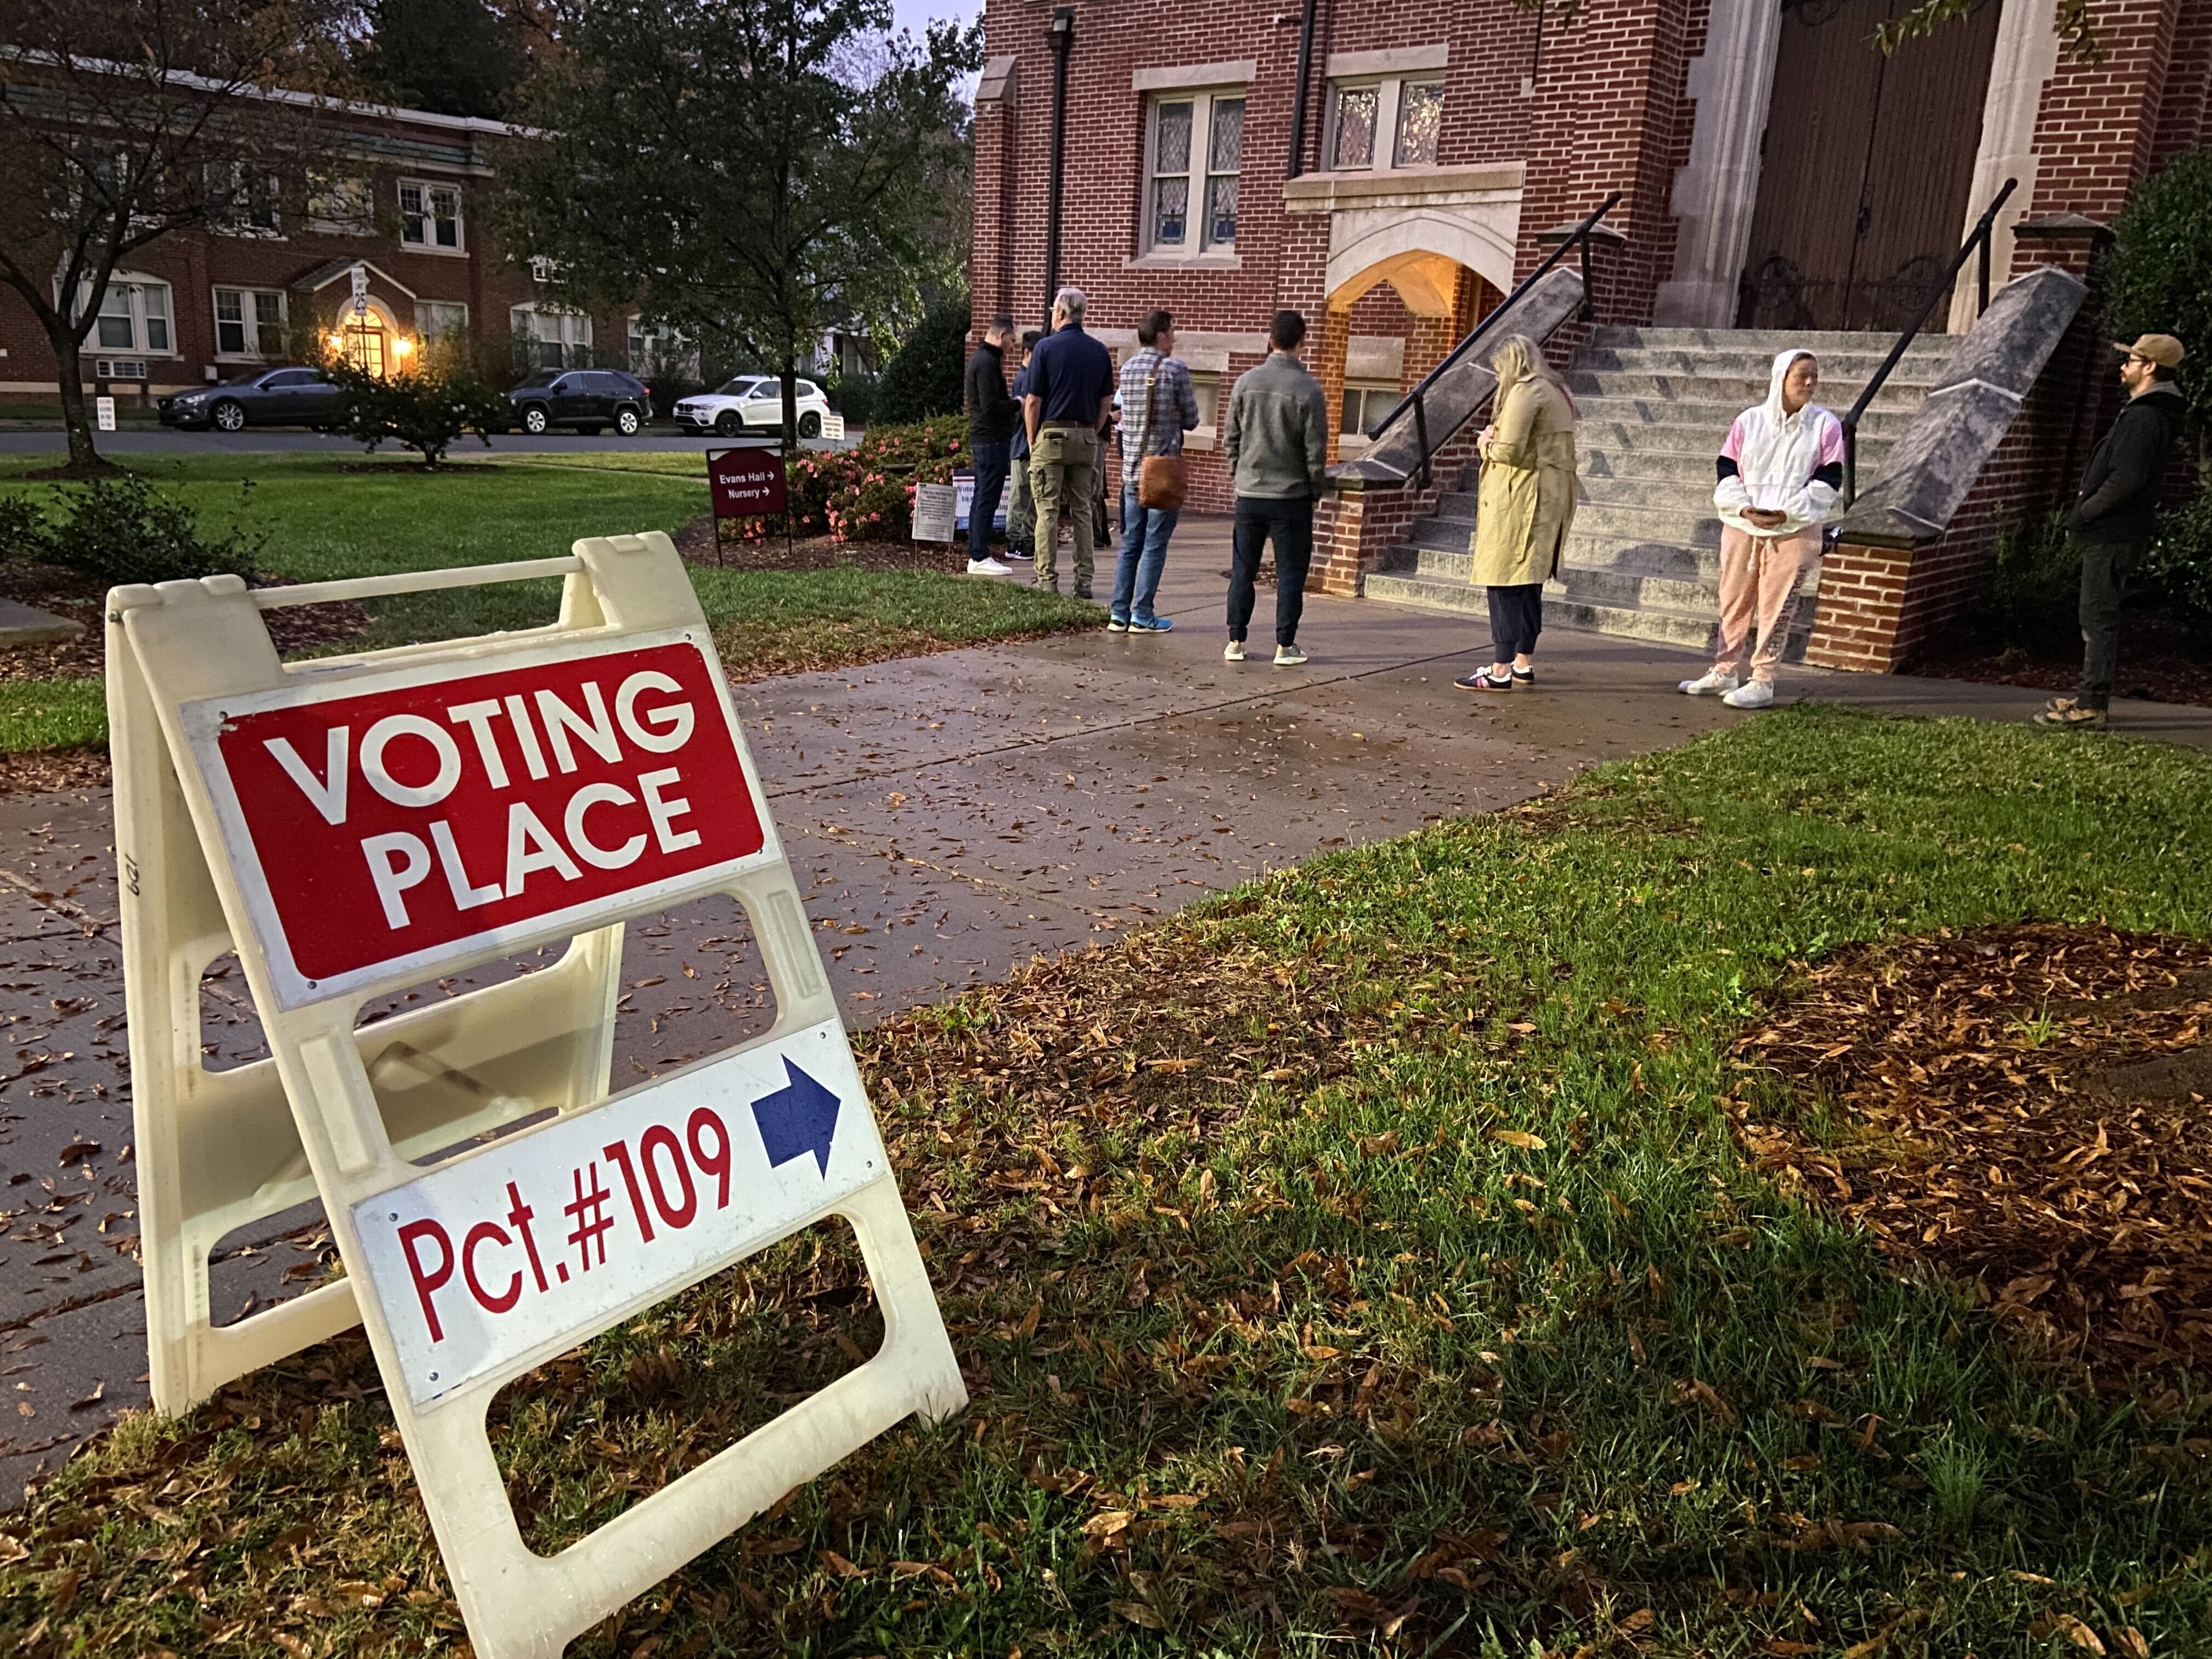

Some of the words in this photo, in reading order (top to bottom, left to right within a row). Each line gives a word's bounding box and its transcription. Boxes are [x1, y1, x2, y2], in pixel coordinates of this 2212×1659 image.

[355, 292, 365, 310] 25
[719, 474, 746, 484] Evans
[748, 471, 765, 482] Hall
[728, 488, 760, 499] Nursery
[263, 671, 695, 825] VOTING
[361, 767, 702, 929] PLACE
